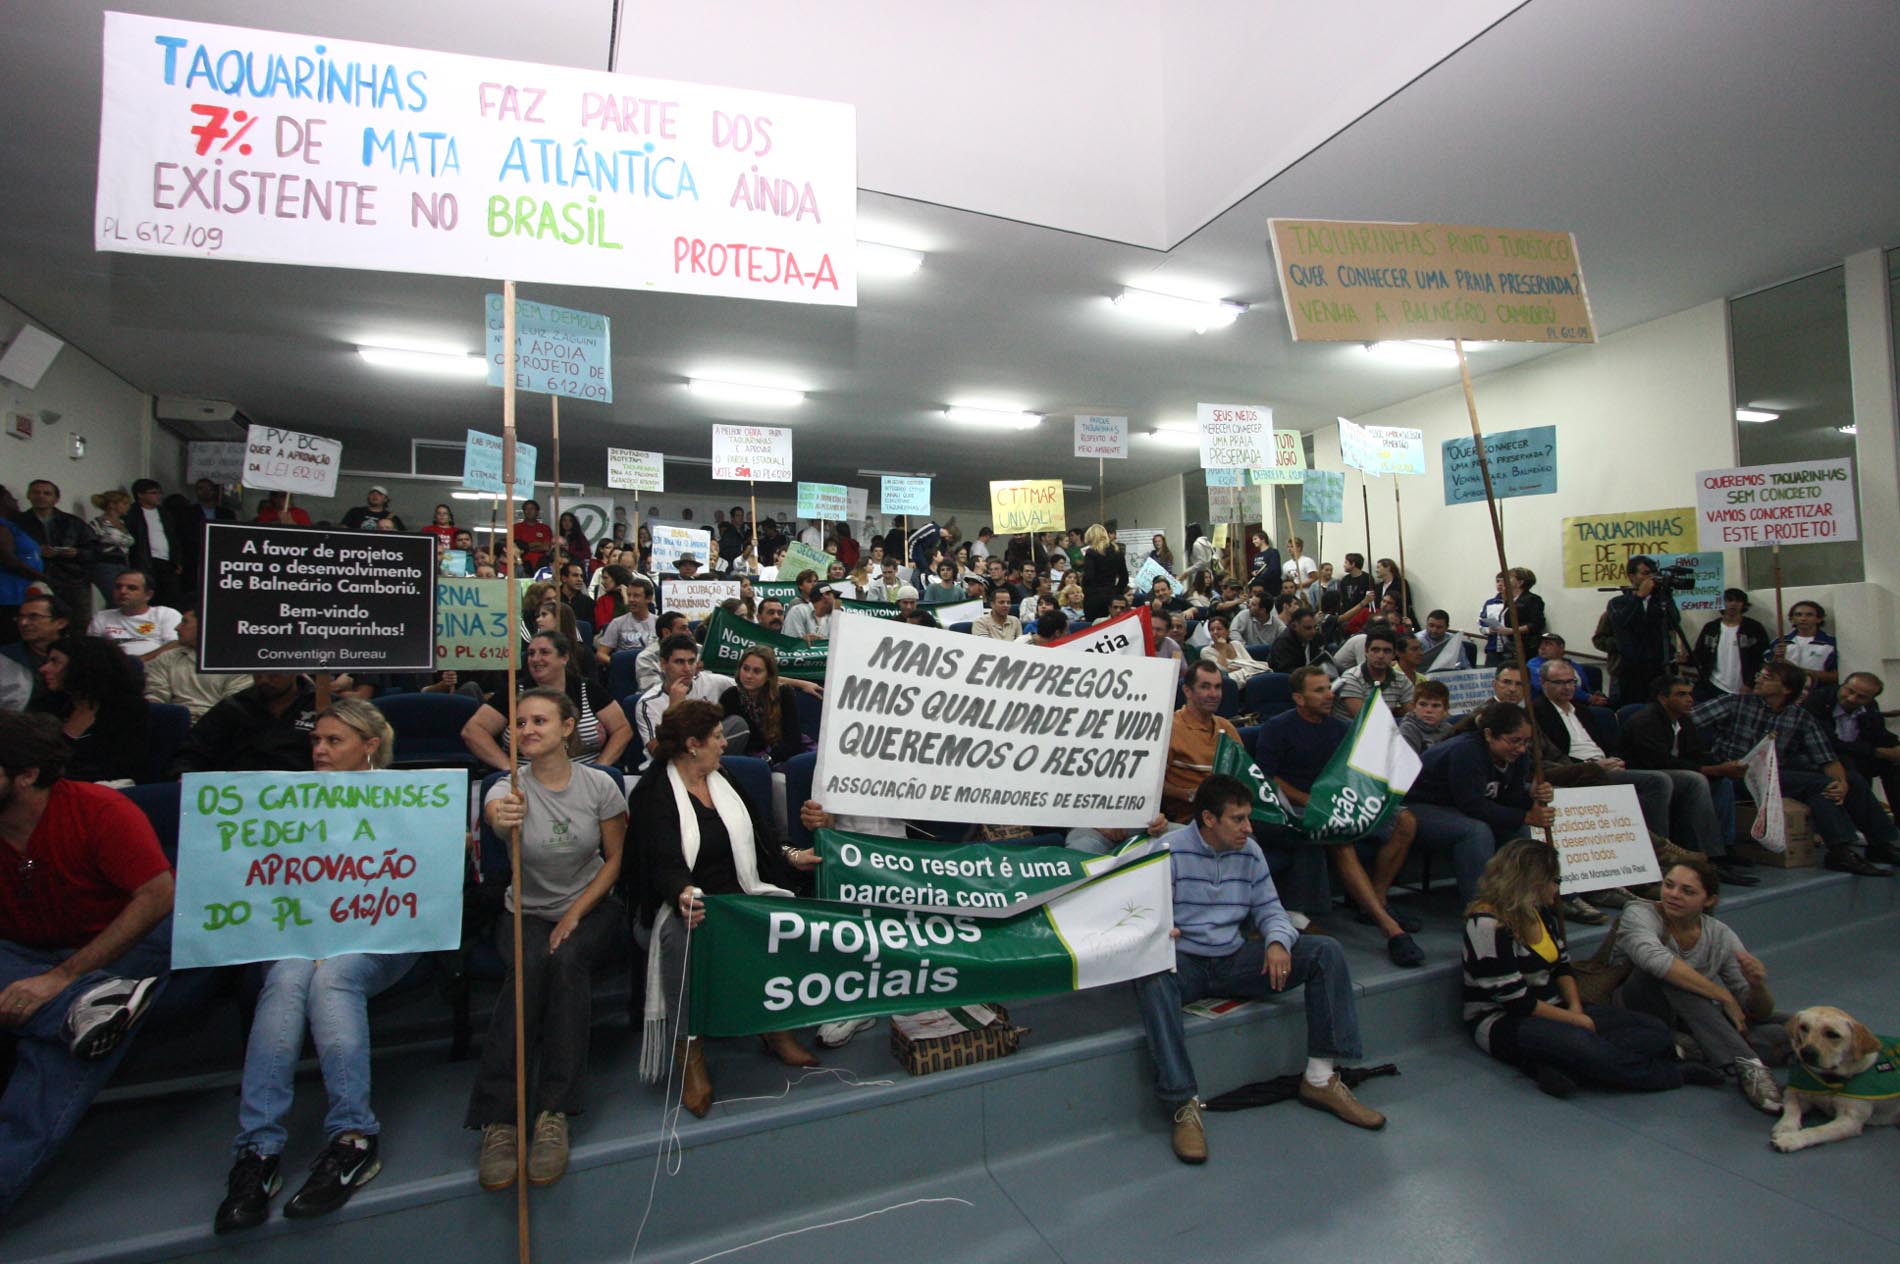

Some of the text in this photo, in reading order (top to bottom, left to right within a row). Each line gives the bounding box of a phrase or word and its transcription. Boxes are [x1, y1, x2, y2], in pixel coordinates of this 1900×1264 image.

[154, 35, 773, 156] TAQUARINHAS FAZ PARTE DOS
[190, 103, 822, 223] 7% DE MATA ATLÂNTICA AINDA
[154, 158, 623, 250] EXISTENTE NO BRASIL
[103, 215, 129, 242] PL
[1289, 225, 1436, 257] TAQUARINHAS
[674, 236, 838, 291] PROTEJA-A
[1290, 264, 1580, 295] QUER CONHECER UMA PRAIA PRESERVADA?
[492, 299, 544, 321] ODEM
[1300, 301, 1360, 323] VENHA
[1376, 301, 1389, 321] A
[531, 341, 586, 362] APOIA
[590, 366, 605, 380] DE
[547, 377, 607, 400] 612/09
[1213, 409, 1258, 421] SEUS NETOS
[1203, 423, 1231, 434] MERECEM
[250, 445, 272, 456] QUER
[277, 449, 284, 457] A
[1210, 448, 1261, 465] PRESERVADA
[1704, 468, 1847, 489] QUEREMOS TAQUARINHAS
[997, 486, 1056, 505] CTTMAR
[1727, 486, 1822, 504] SEM CONCRETO
[999, 511, 1052, 528] UNIVALI
[1707, 503, 1832, 523] VAMOS CONCRETIZAR
[1574, 517, 1683, 541] TAQUARINHAS
[1723, 520, 1837, 542] ESTE PROJETO!
[242, 540, 404, 564] A favor de projetos
[1596, 544, 1616, 562] DE
[220, 559, 422, 579] para o desenvolvimento
[1580, 563, 1628, 582] E PARA
[220, 575, 421, 595] de Balneário Camboriú.
[437, 584, 488, 608] RNAL
[672, 582, 735, 596] A OCUPAÇÃO DE
[768, 588, 796, 597] com
[280, 603, 369, 619] Bem-vindo
[238, 621, 405, 639] Resort Taquarinhas!
[490, 612, 508, 637] 3
[258, 648, 386, 660] Convention Bureau
[455, 645, 475, 658] PL
[867, 636, 1148, 702] MAIS EMPREGOS...
[837, 675, 1165, 742] MAIS QUALIDADE DE VIDA
[839, 721, 1149, 779] QUEREMOS O RESORT
[197, 783, 451, 816] OS CATARINENSES
[826, 775, 1147, 811] ASSOCIAÇÃO DE MORADORES DE ESTALEIRO
[216, 817, 376, 852] PEDEM A
[1599, 819, 1609, 829] de
[1562, 832, 1636, 849] desenvolvimento
[245, 848, 417, 887] APROVAÇÃO
[840, 844, 1072, 879] O eco resort é uma
[1566, 849, 1617, 864] para todos
[839, 881, 949, 908] parceria
[956, 888, 1008, 909] com
[202, 887, 418, 932] DO PL 612/09
[767, 910, 982, 963] Projetos
[763, 959, 958, 1012] sociais
